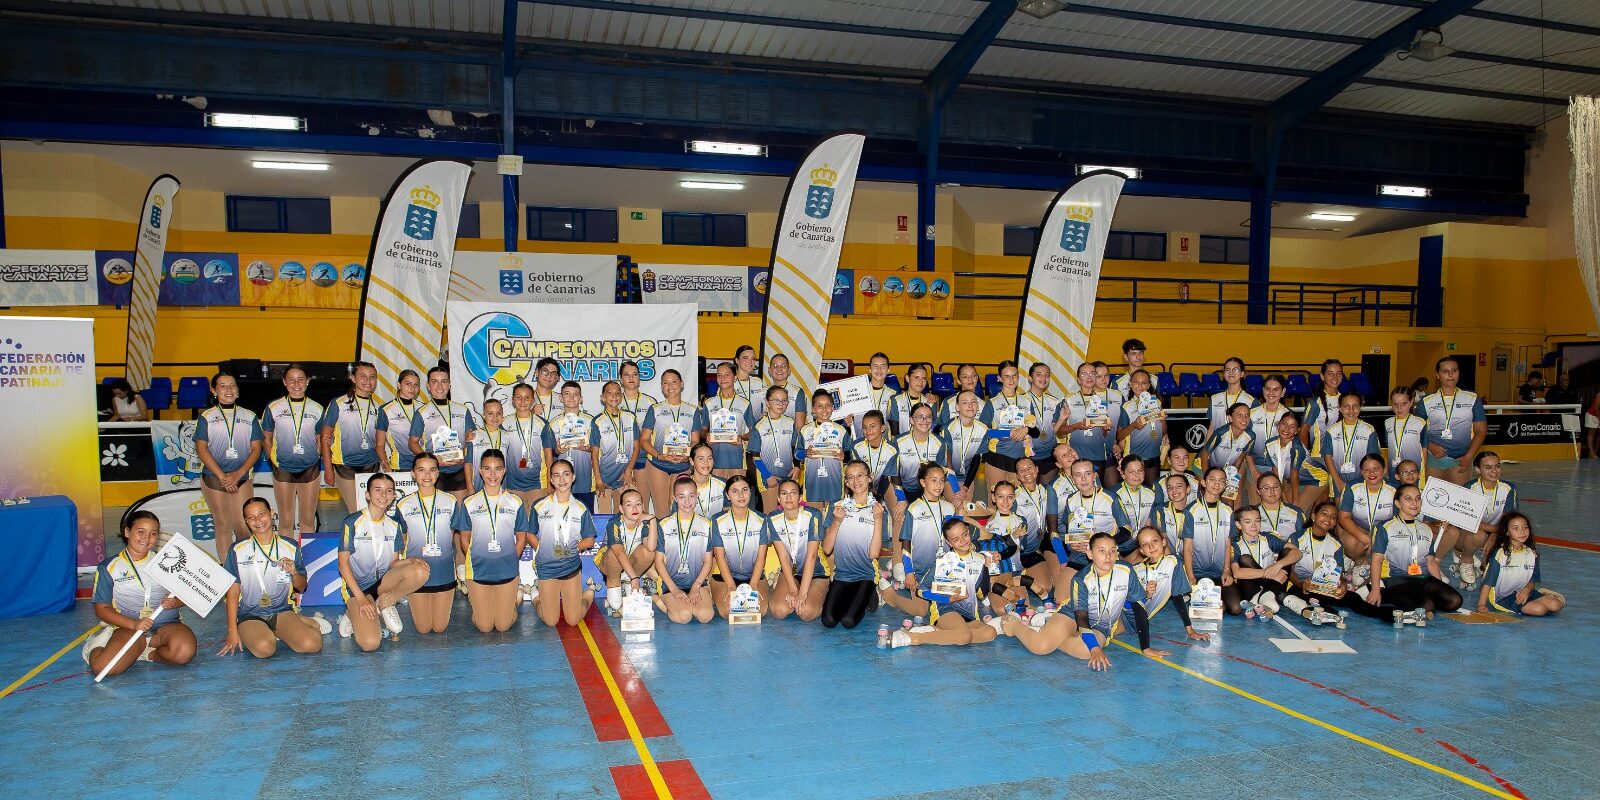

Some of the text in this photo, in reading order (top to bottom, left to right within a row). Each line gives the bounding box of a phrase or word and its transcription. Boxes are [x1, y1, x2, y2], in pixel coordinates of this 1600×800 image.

[796, 222, 832, 233] Gobierno
[790, 230, 835, 242] de Canarias
[393, 241, 439, 258] Gobierno
[386, 248, 443, 268] de Canarias
[1050, 255, 1089, 268] Gobierno
[0, 264, 88, 273] MPEONATOS
[1043, 263, 1092, 277] de Canarias
[1, 272, 88, 282] CANARIAS
[528, 272, 583, 282] Gobierno
[659, 275, 742, 284] CAMPEONATOS
[527, 284, 596, 294] de Canarias
[659, 282, 742, 291] DE CANARIAS
[492, 338, 686, 360] CAMPEONATOS DE
[0, 352, 85, 363] FEDERACIÓN
[0, 365, 83, 375] CANARIA DE
[0, 377, 63, 387] PATINAJ
[1521, 422, 1561, 431] GranCanaria
[177, 574, 192, 587] GRAN
